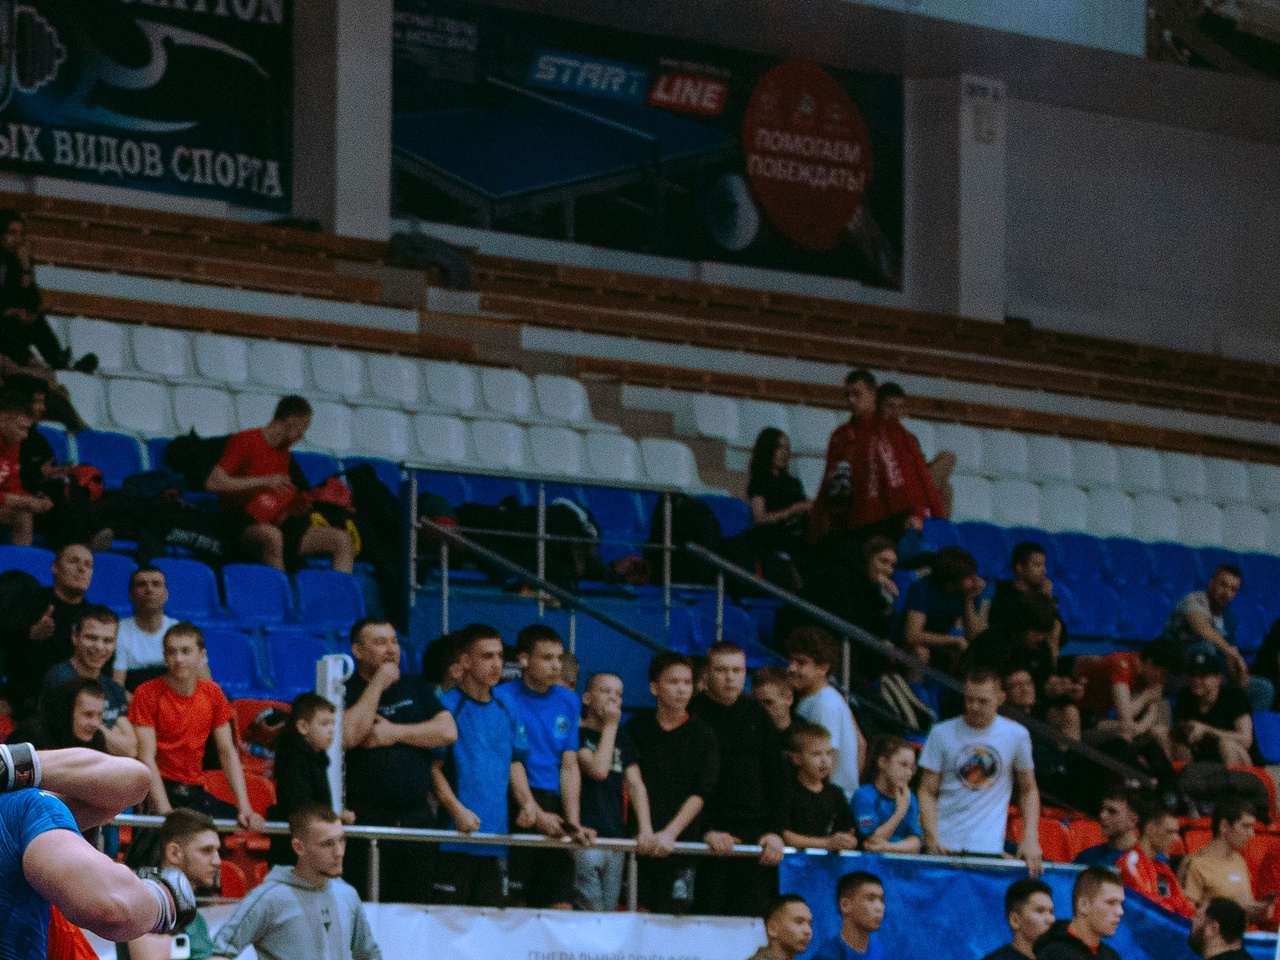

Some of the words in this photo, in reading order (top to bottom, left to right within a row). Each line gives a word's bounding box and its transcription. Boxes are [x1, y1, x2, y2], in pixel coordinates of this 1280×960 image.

[654, 74, 722, 110] LINE
[53, 128, 164, 178] ВИДОВ
[170, 145, 285, 197] СПОРТА
